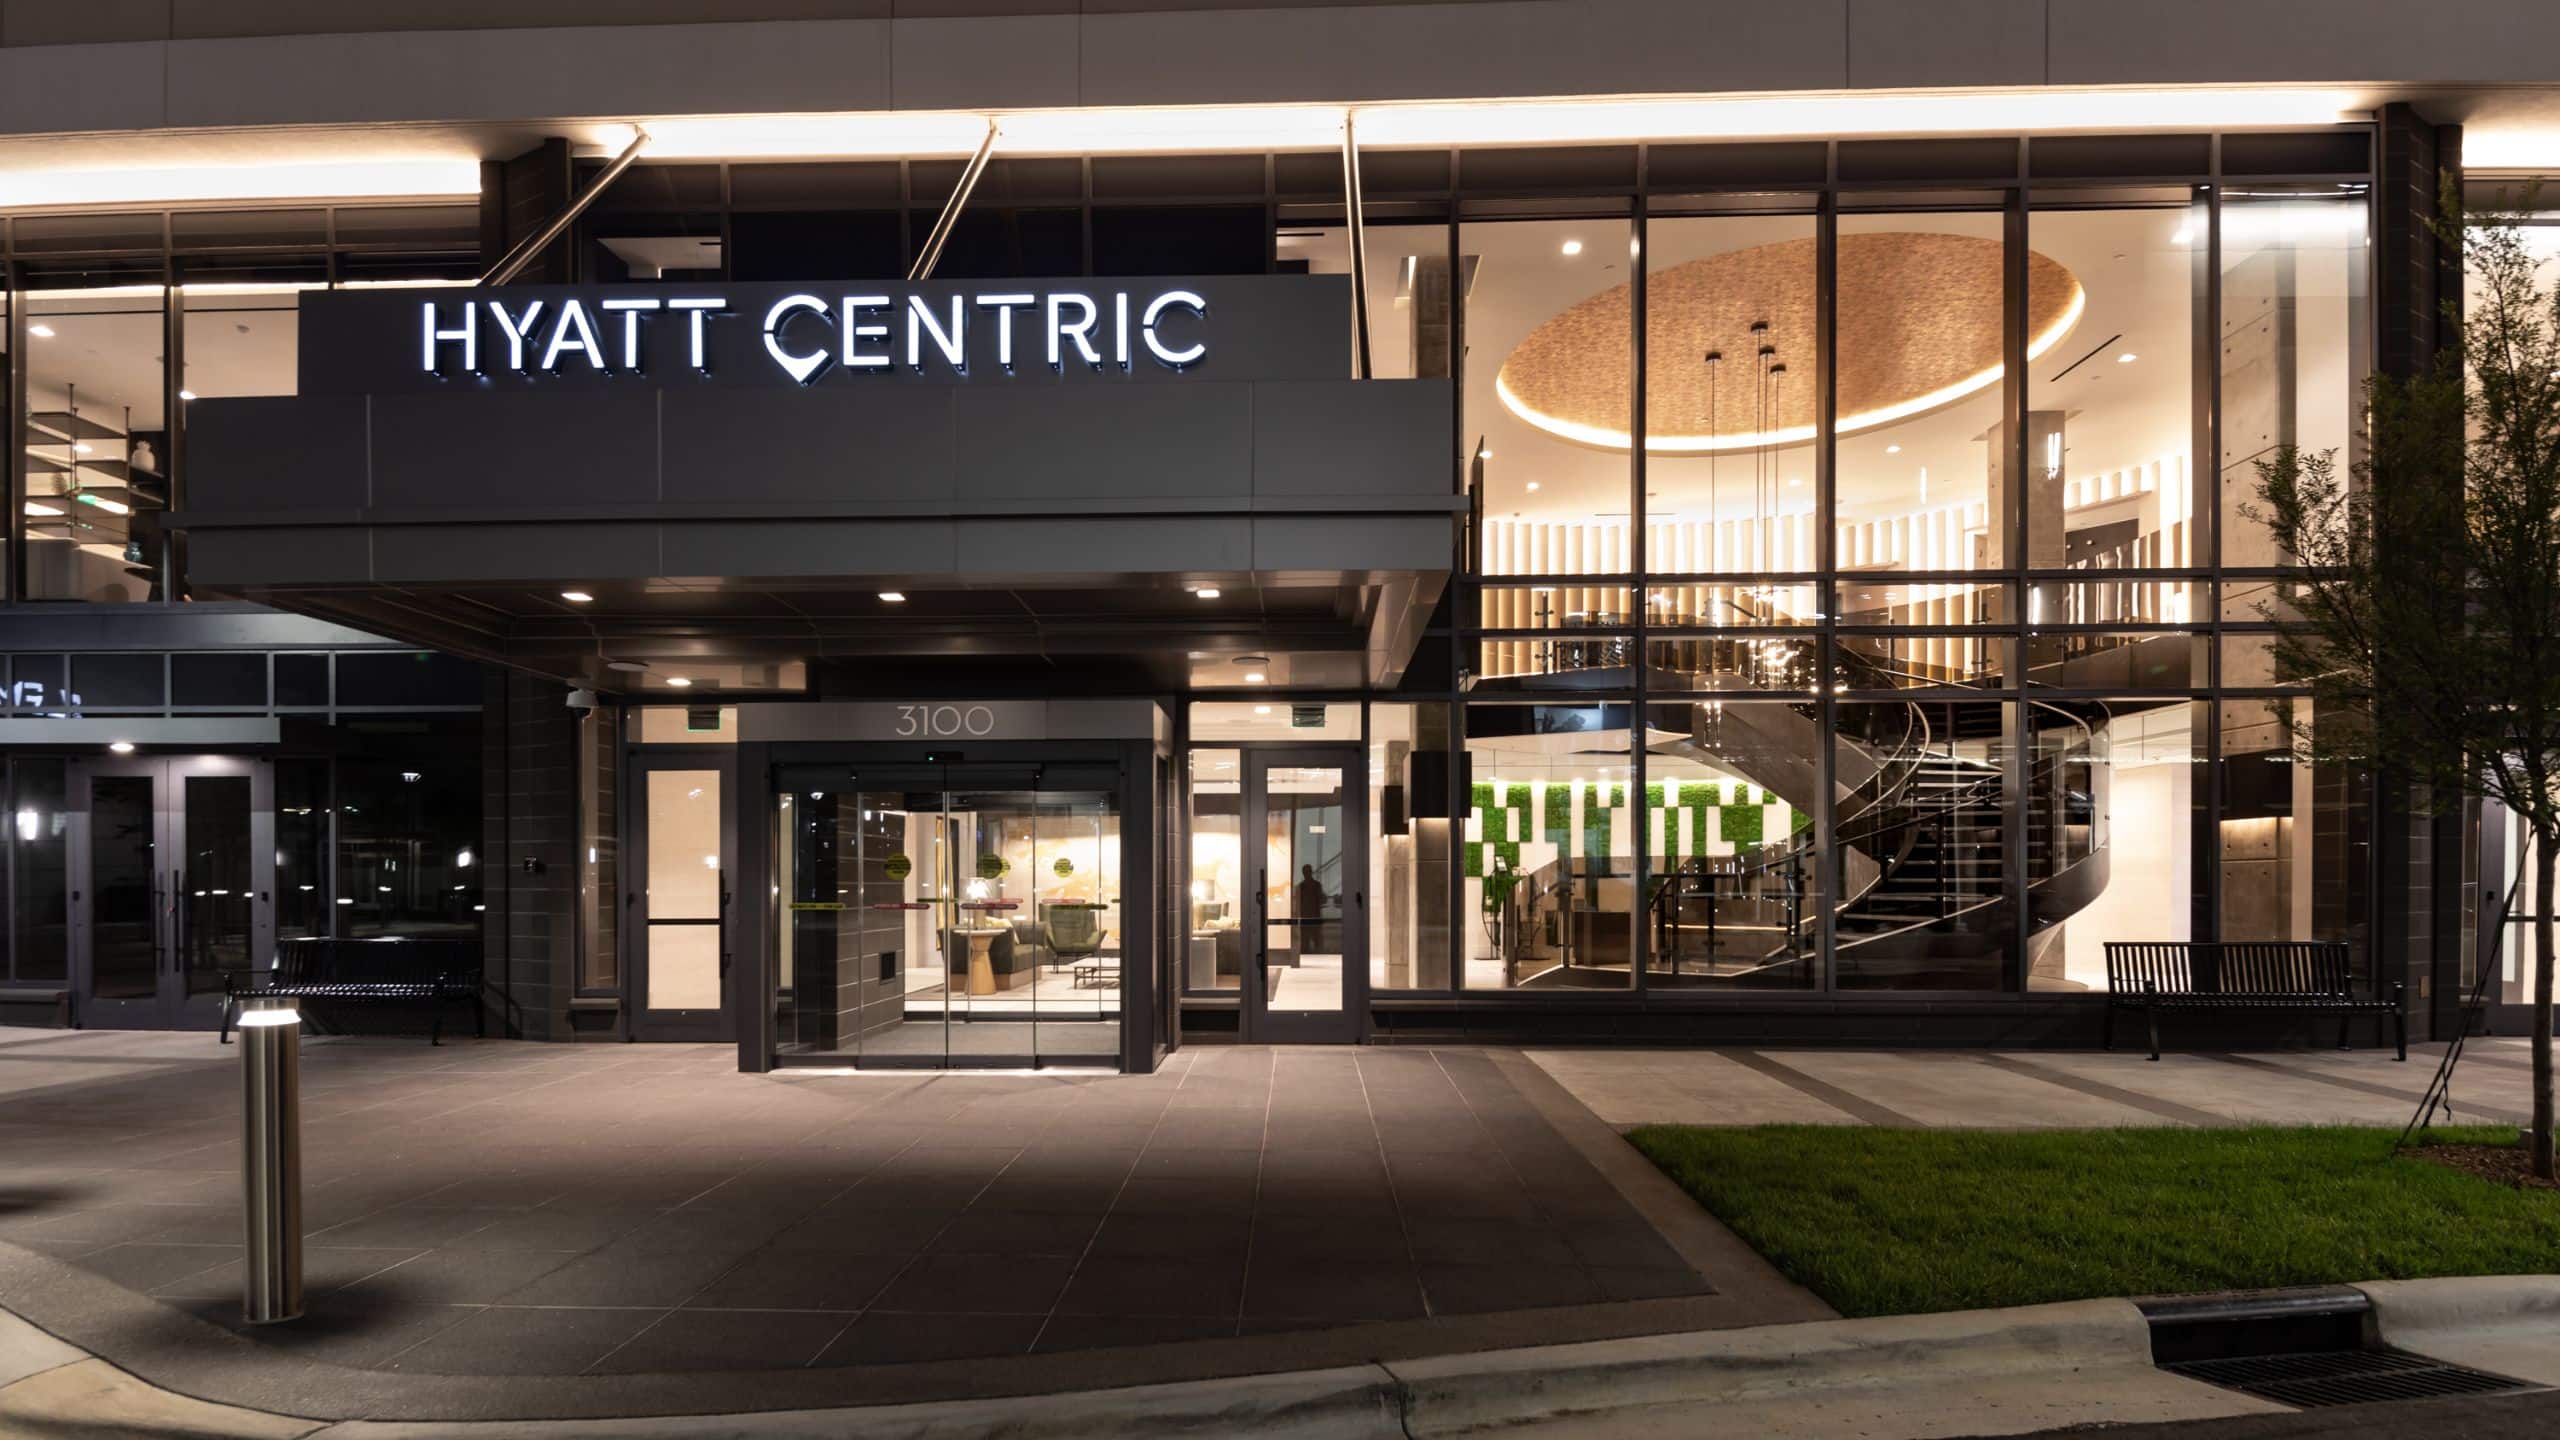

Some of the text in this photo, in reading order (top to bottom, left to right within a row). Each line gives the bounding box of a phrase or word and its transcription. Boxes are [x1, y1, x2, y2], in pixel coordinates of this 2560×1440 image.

[423, 290, 1206, 384] HYATT CENTRIC
[895, 705, 994, 736] 3100
